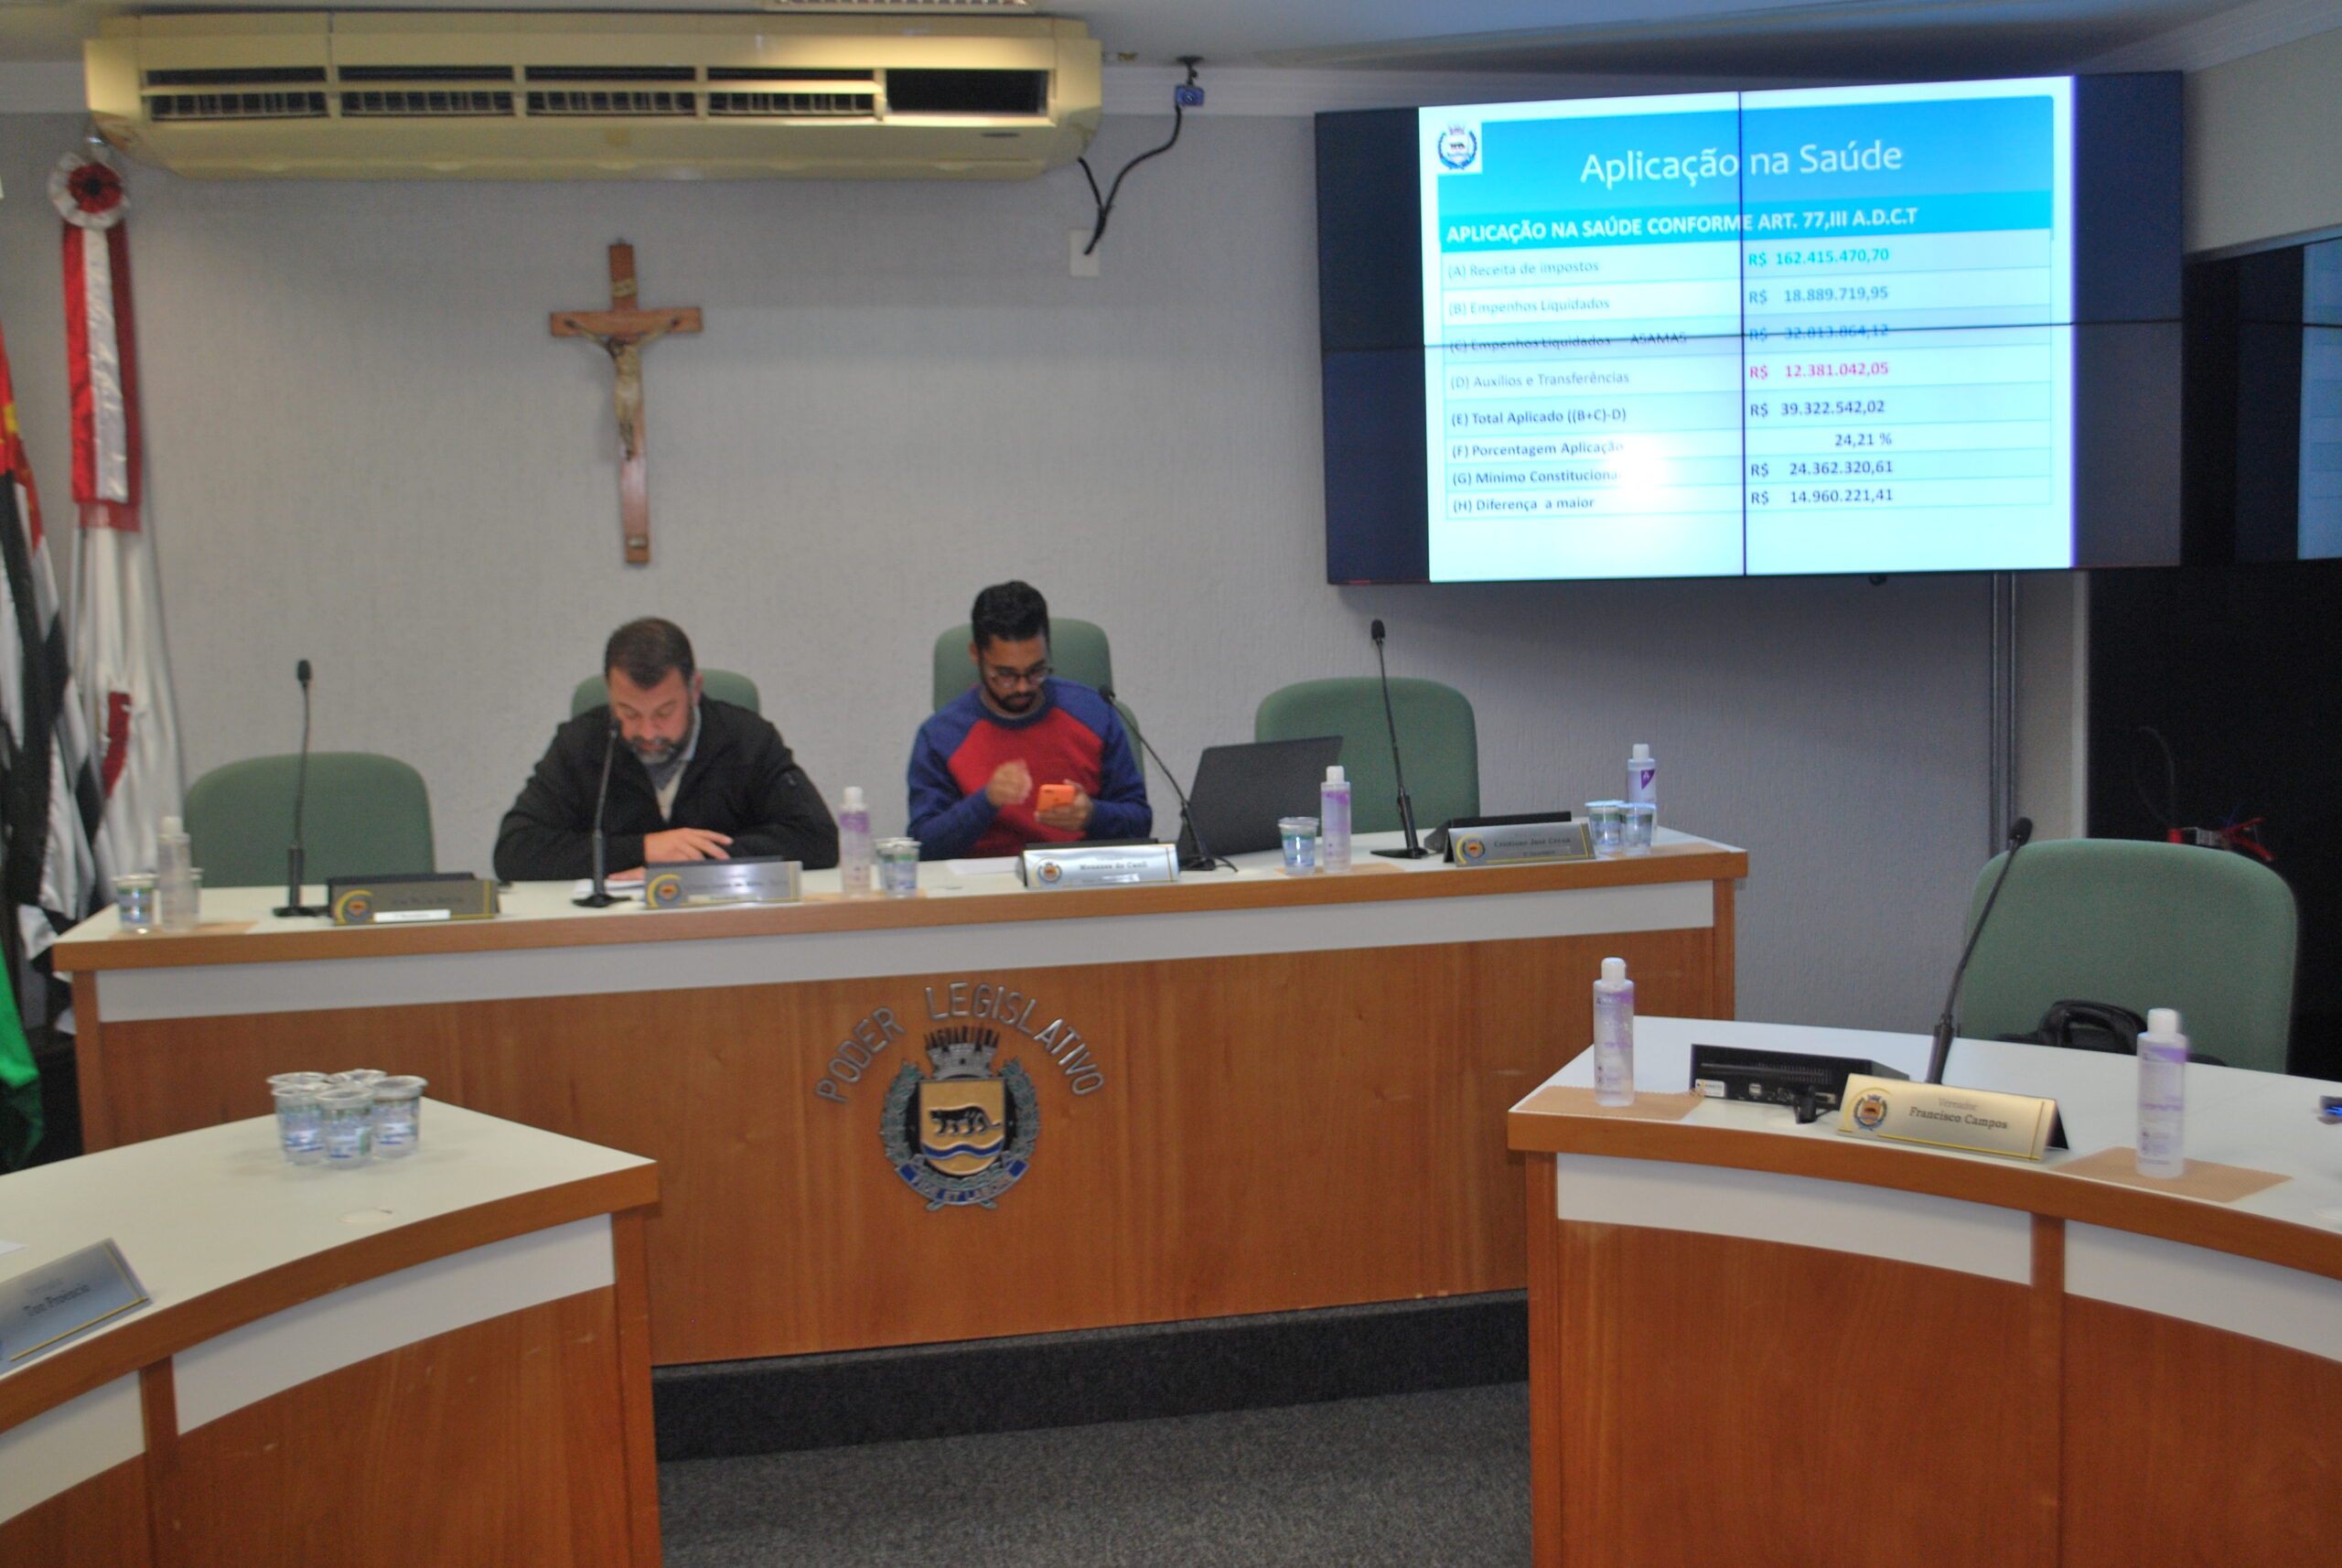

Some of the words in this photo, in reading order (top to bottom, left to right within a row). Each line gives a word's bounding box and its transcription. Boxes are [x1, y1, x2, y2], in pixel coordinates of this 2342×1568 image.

[1580, 147, 1738, 189] Aplicação
[1750, 152, 1789, 175] na
[1799, 139, 1902, 174] Saúde
[1446, 220, 1546, 243] APLICAÇÃO
[1552, 221, 1579, 239] NA
[1582, 216, 1642, 237] SAÚDE
[1647, 214, 1753, 234] CONFORME
[1757, 212, 1798, 231] ART.
[1803, 210, 1847, 231] 77,III
[1853, 208, 1918, 226] A.D.C.T
[1748, 252, 1767, 266] R$
[1776, 248, 1889, 265] 162.415.470,70
[1447, 263, 1466, 280] (A)
[1470, 263, 1516, 276] Receita
[1520, 263, 1535, 275] de
[1541, 261, 1599, 277] impostos
[1748, 289, 1767, 305] R$
[1784, 286, 1888, 303] 18.889.719,95
[1449, 302, 1466, 317] (B)
[1470, 302, 1538, 317] Empenhos
[1542, 299, 1610, 315] Liquidados
[1471, 338, 1539, 352] Empenhos
[1542, 335, 1611, 349] Liquidados
[1749, 328, 1767, 342] R$
[1451, 376, 1469, 390] (D)
[1526, 377, 1534, 386] e
[1538, 371, 1629, 386] Transferências
[1750, 365, 1768, 381] R$
[1786, 362, 1888, 378] 12.381.042,05
[1452, 413, 1468, 427] (E)
[1472, 412, 1503, 424] Total
[1507, 410, 1563, 425] Aplicado
[1567, 408, 1627, 424] ((B+C)-D)
[1750, 403, 1768, 418] R$
[1781, 400, 1885, 416] 39.322.542,02
[1453, 446, 1468, 458] (F)
[1472, 444, 1556, 457] Porcentagem
[1560, 440, 1624, 455] Aplicação
[1834, 434, 1874, 448] 24,21
[1879, 433, 1892, 446] %
[1453, 473, 1471, 487] (G)
[1530, 468, 1622, 484] Constituciona
[1750, 462, 1768, 478] R$
[1789, 460, 1893, 476] 24.362.320,61
[1454, 499, 1472, 512] (H)
[1477, 499, 1538, 512] Diferença
[1545, 500, 1552, 509] a
[1556, 497, 1595, 509] maior
[1750, 491, 1769, 505] R$
[1790, 489, 1893, 503] 14.960.221,41
[814, 1006, 906, 1103] PODER
[925, 982, 1104, 1096] LEGISLATIVO
[1909, 1105, 1961, 1122] Francisco
[1964, 1113, 2008, 1130] Campos
